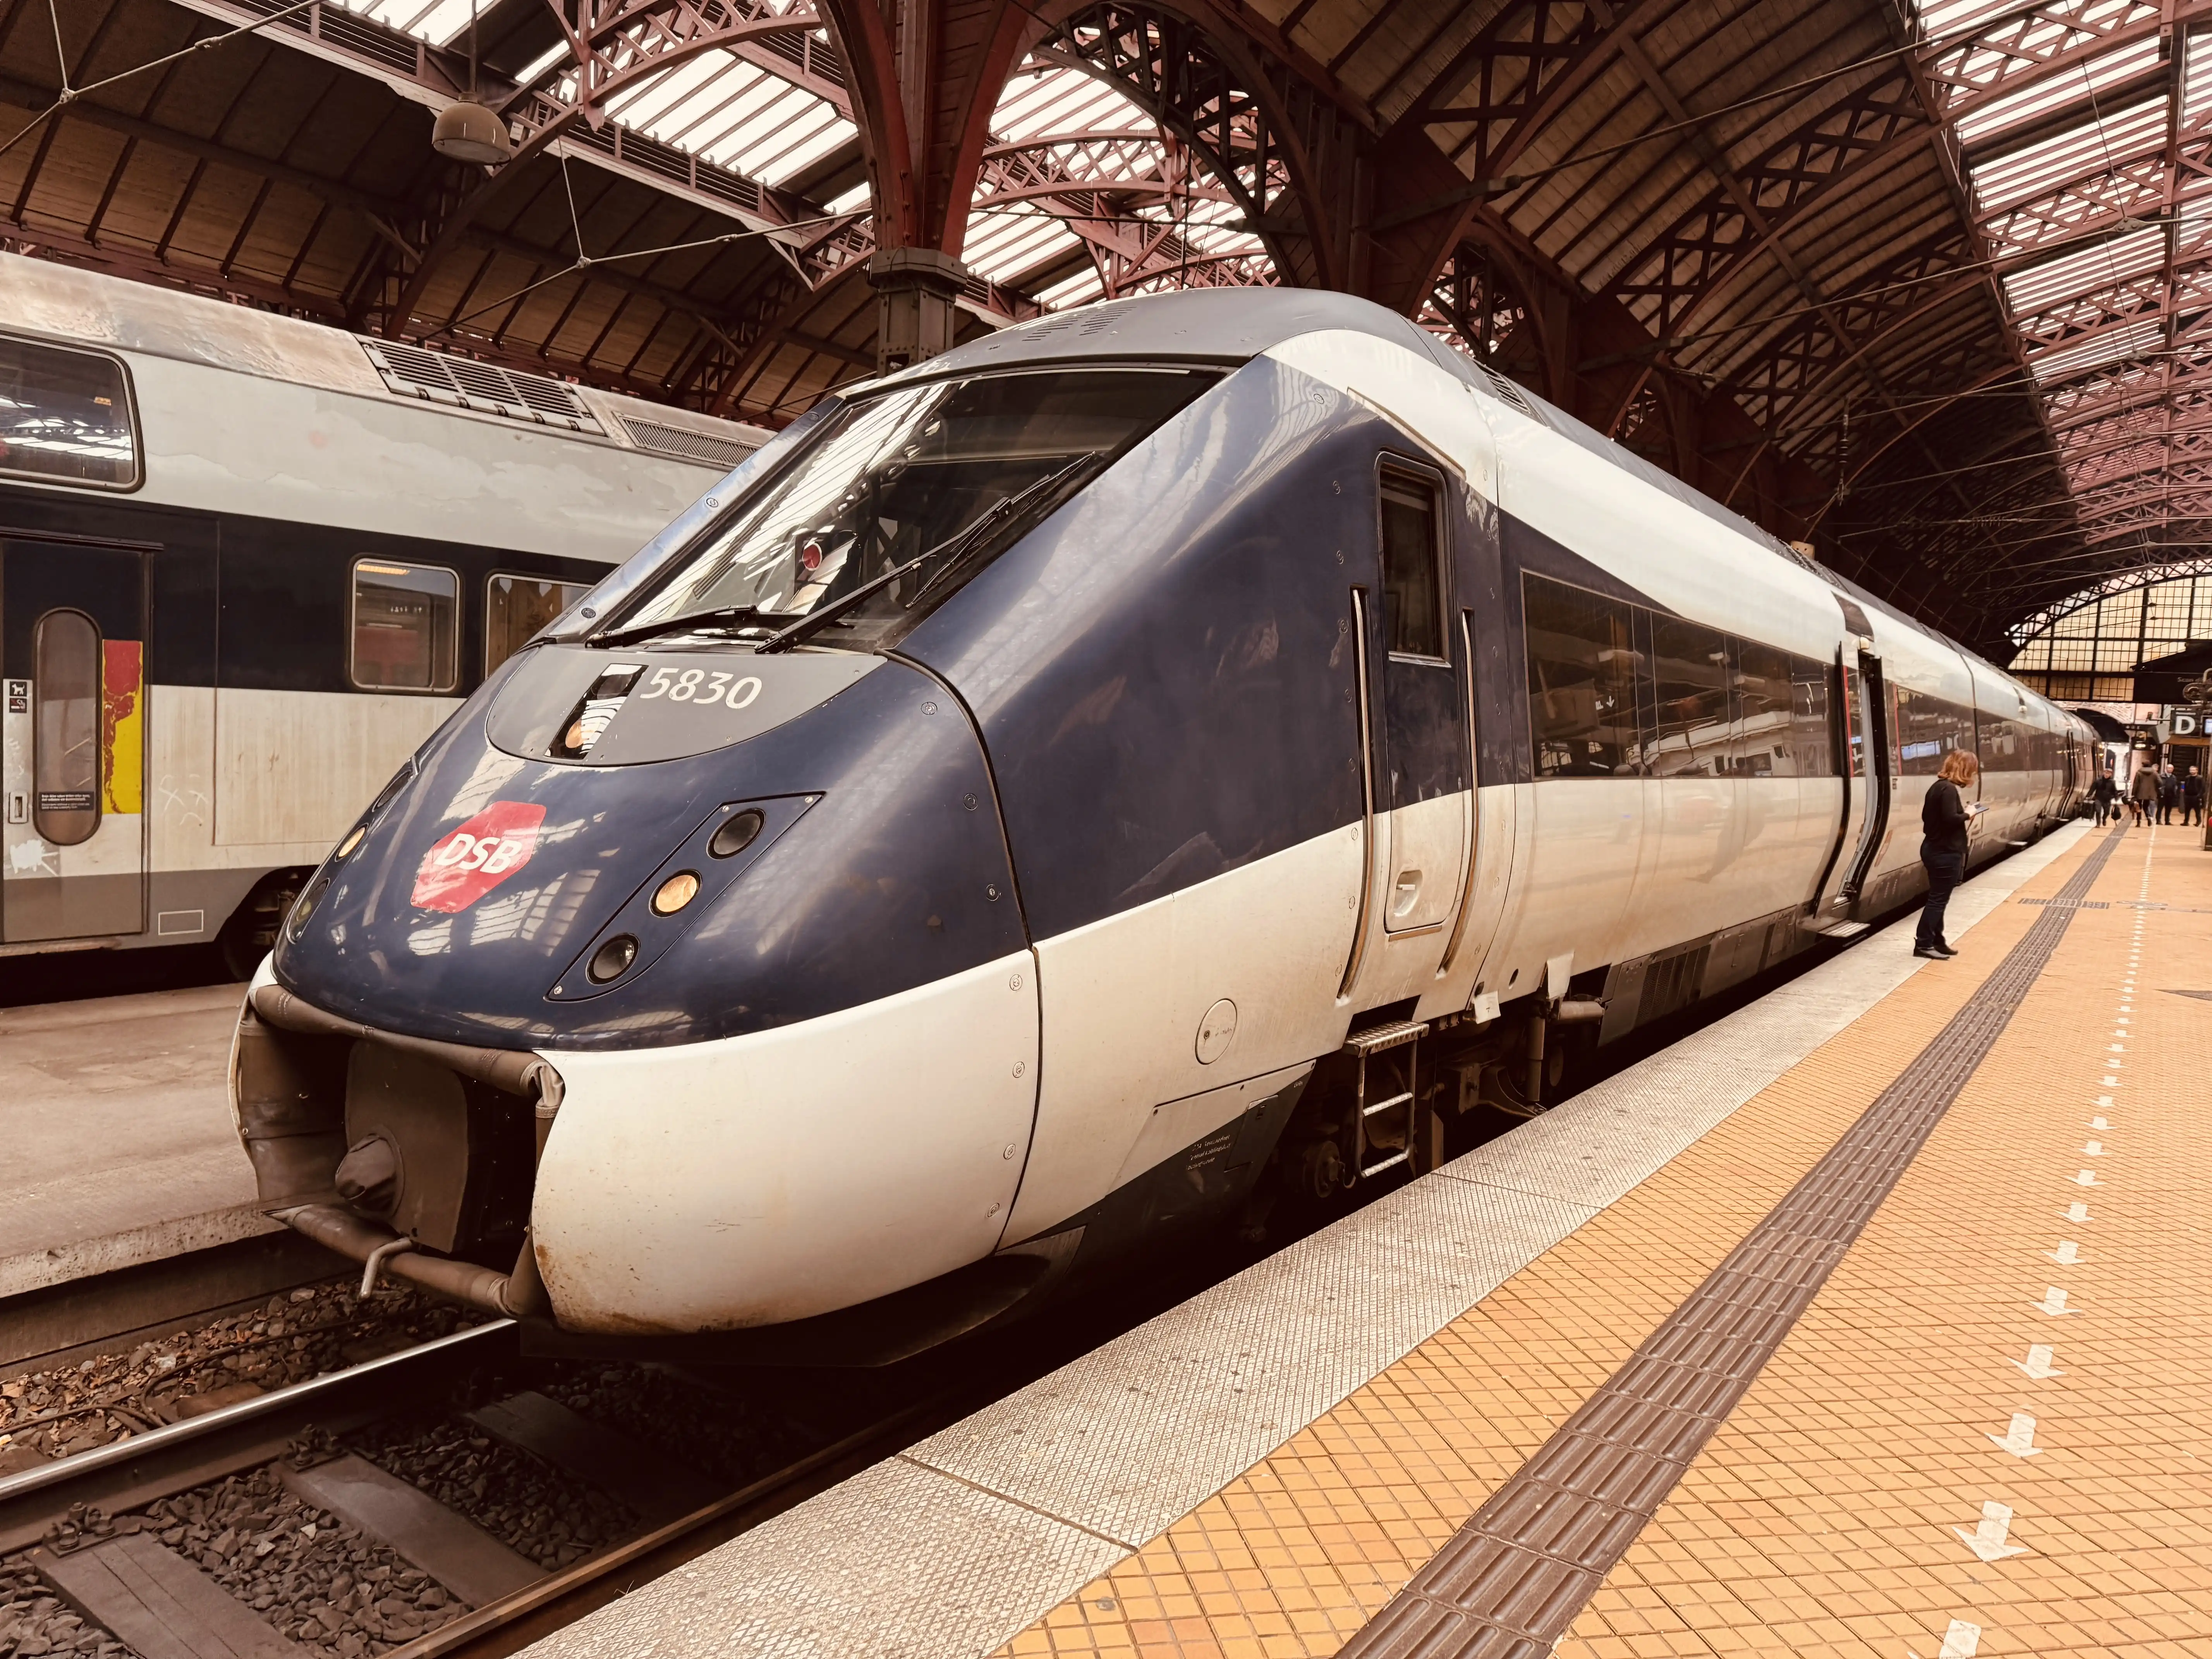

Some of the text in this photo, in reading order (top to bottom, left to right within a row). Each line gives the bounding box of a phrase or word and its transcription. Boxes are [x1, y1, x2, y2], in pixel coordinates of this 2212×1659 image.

[640, 668, 762, 709] 5830
[2175, 716, 2195, 734] D
[434, 833, 522, 874] DSB
